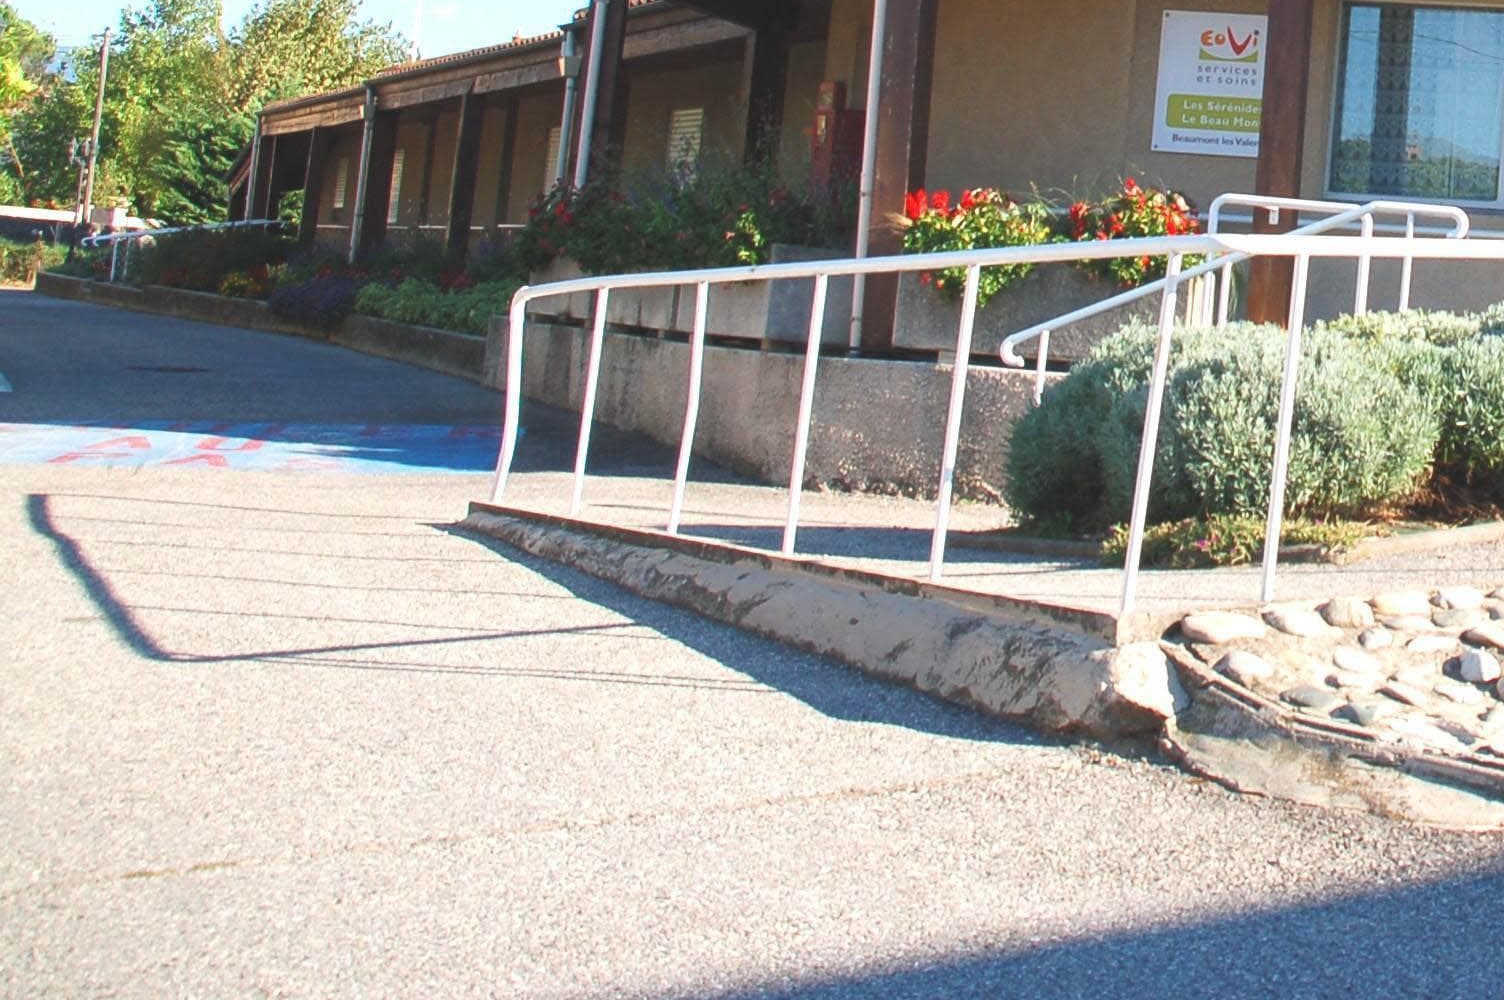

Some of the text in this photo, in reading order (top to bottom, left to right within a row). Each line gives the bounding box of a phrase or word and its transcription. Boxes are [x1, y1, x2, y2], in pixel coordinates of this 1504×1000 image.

[1197, 65, 1257, 76] services
[1218, 77, 1257, 86] soins
[1184, 100, 1203, 110] Les
[1182, 113, 1195, 124] Le
[1200, 115, 1230, 126] Beau
[1172, 134, 1219, 145] Beaumont
